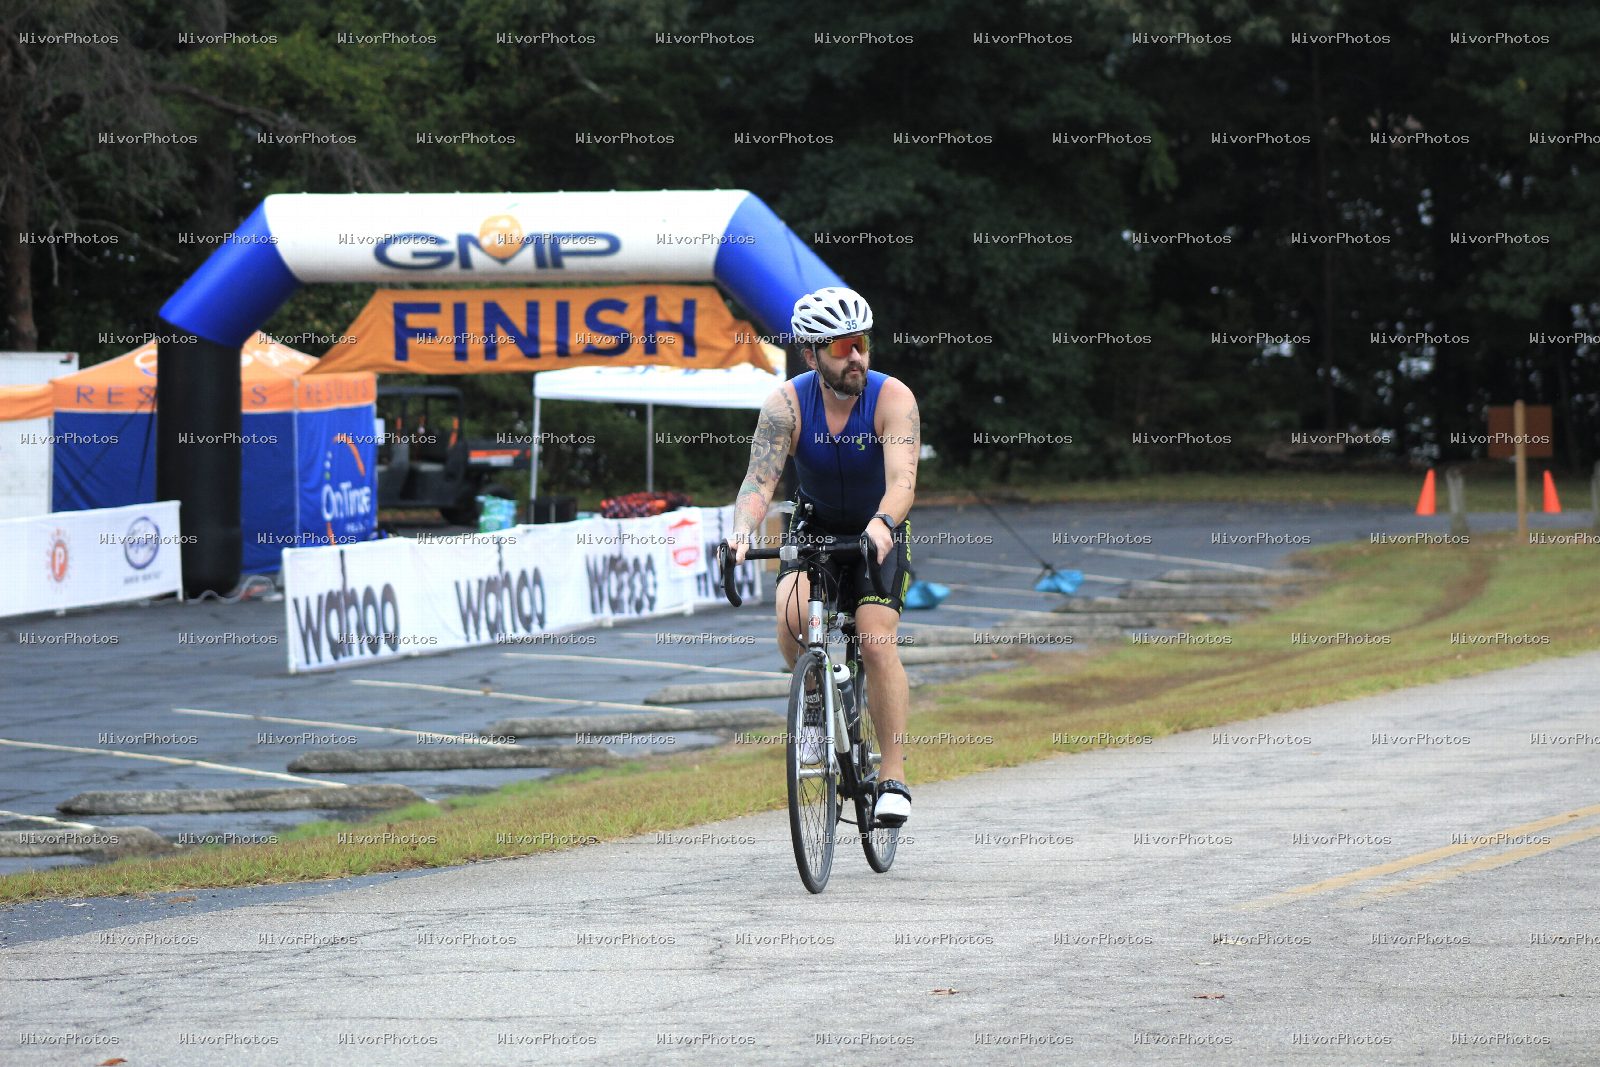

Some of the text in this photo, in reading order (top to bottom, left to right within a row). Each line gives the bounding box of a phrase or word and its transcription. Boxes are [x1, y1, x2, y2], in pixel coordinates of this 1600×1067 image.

[374, 232, 621, 271] GMP
[393, 295, 696, 362] FINISH
[845, 319, 857, 331] 35
[76, 384, 269, 405] RESS
[305, 379, 368, 403] RESULTS
[293, 550, 400, 664] wahoo
[454, 541, 547, 643] wahoo
